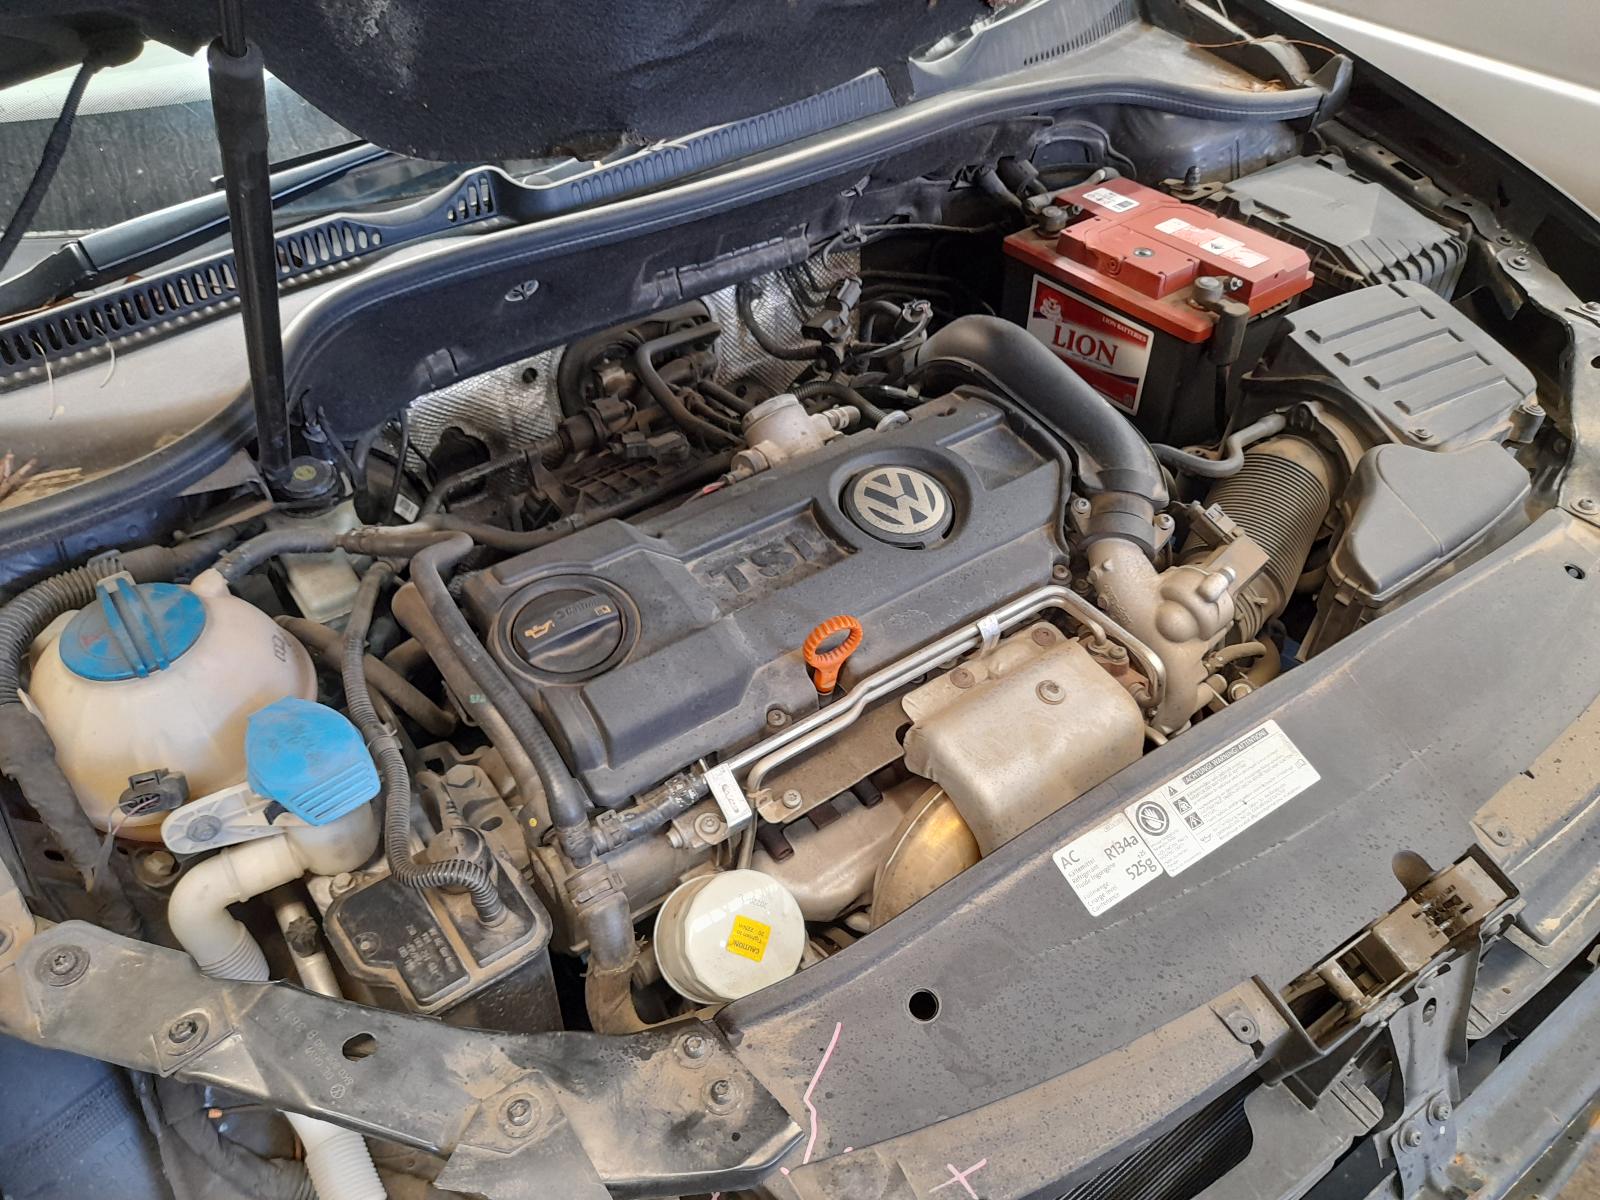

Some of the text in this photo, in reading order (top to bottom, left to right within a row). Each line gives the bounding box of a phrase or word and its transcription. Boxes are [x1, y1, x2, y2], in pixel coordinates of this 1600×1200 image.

[1052, 325, 1118, 366] LION
[853, 466, 946, 535] VW
[705, 531, 817, 593] TSI
[1060, 849, 1080, 870] AC
[1104, 835, 1139, 861] R134a
[1125, 858, 1157, 881] 525g
